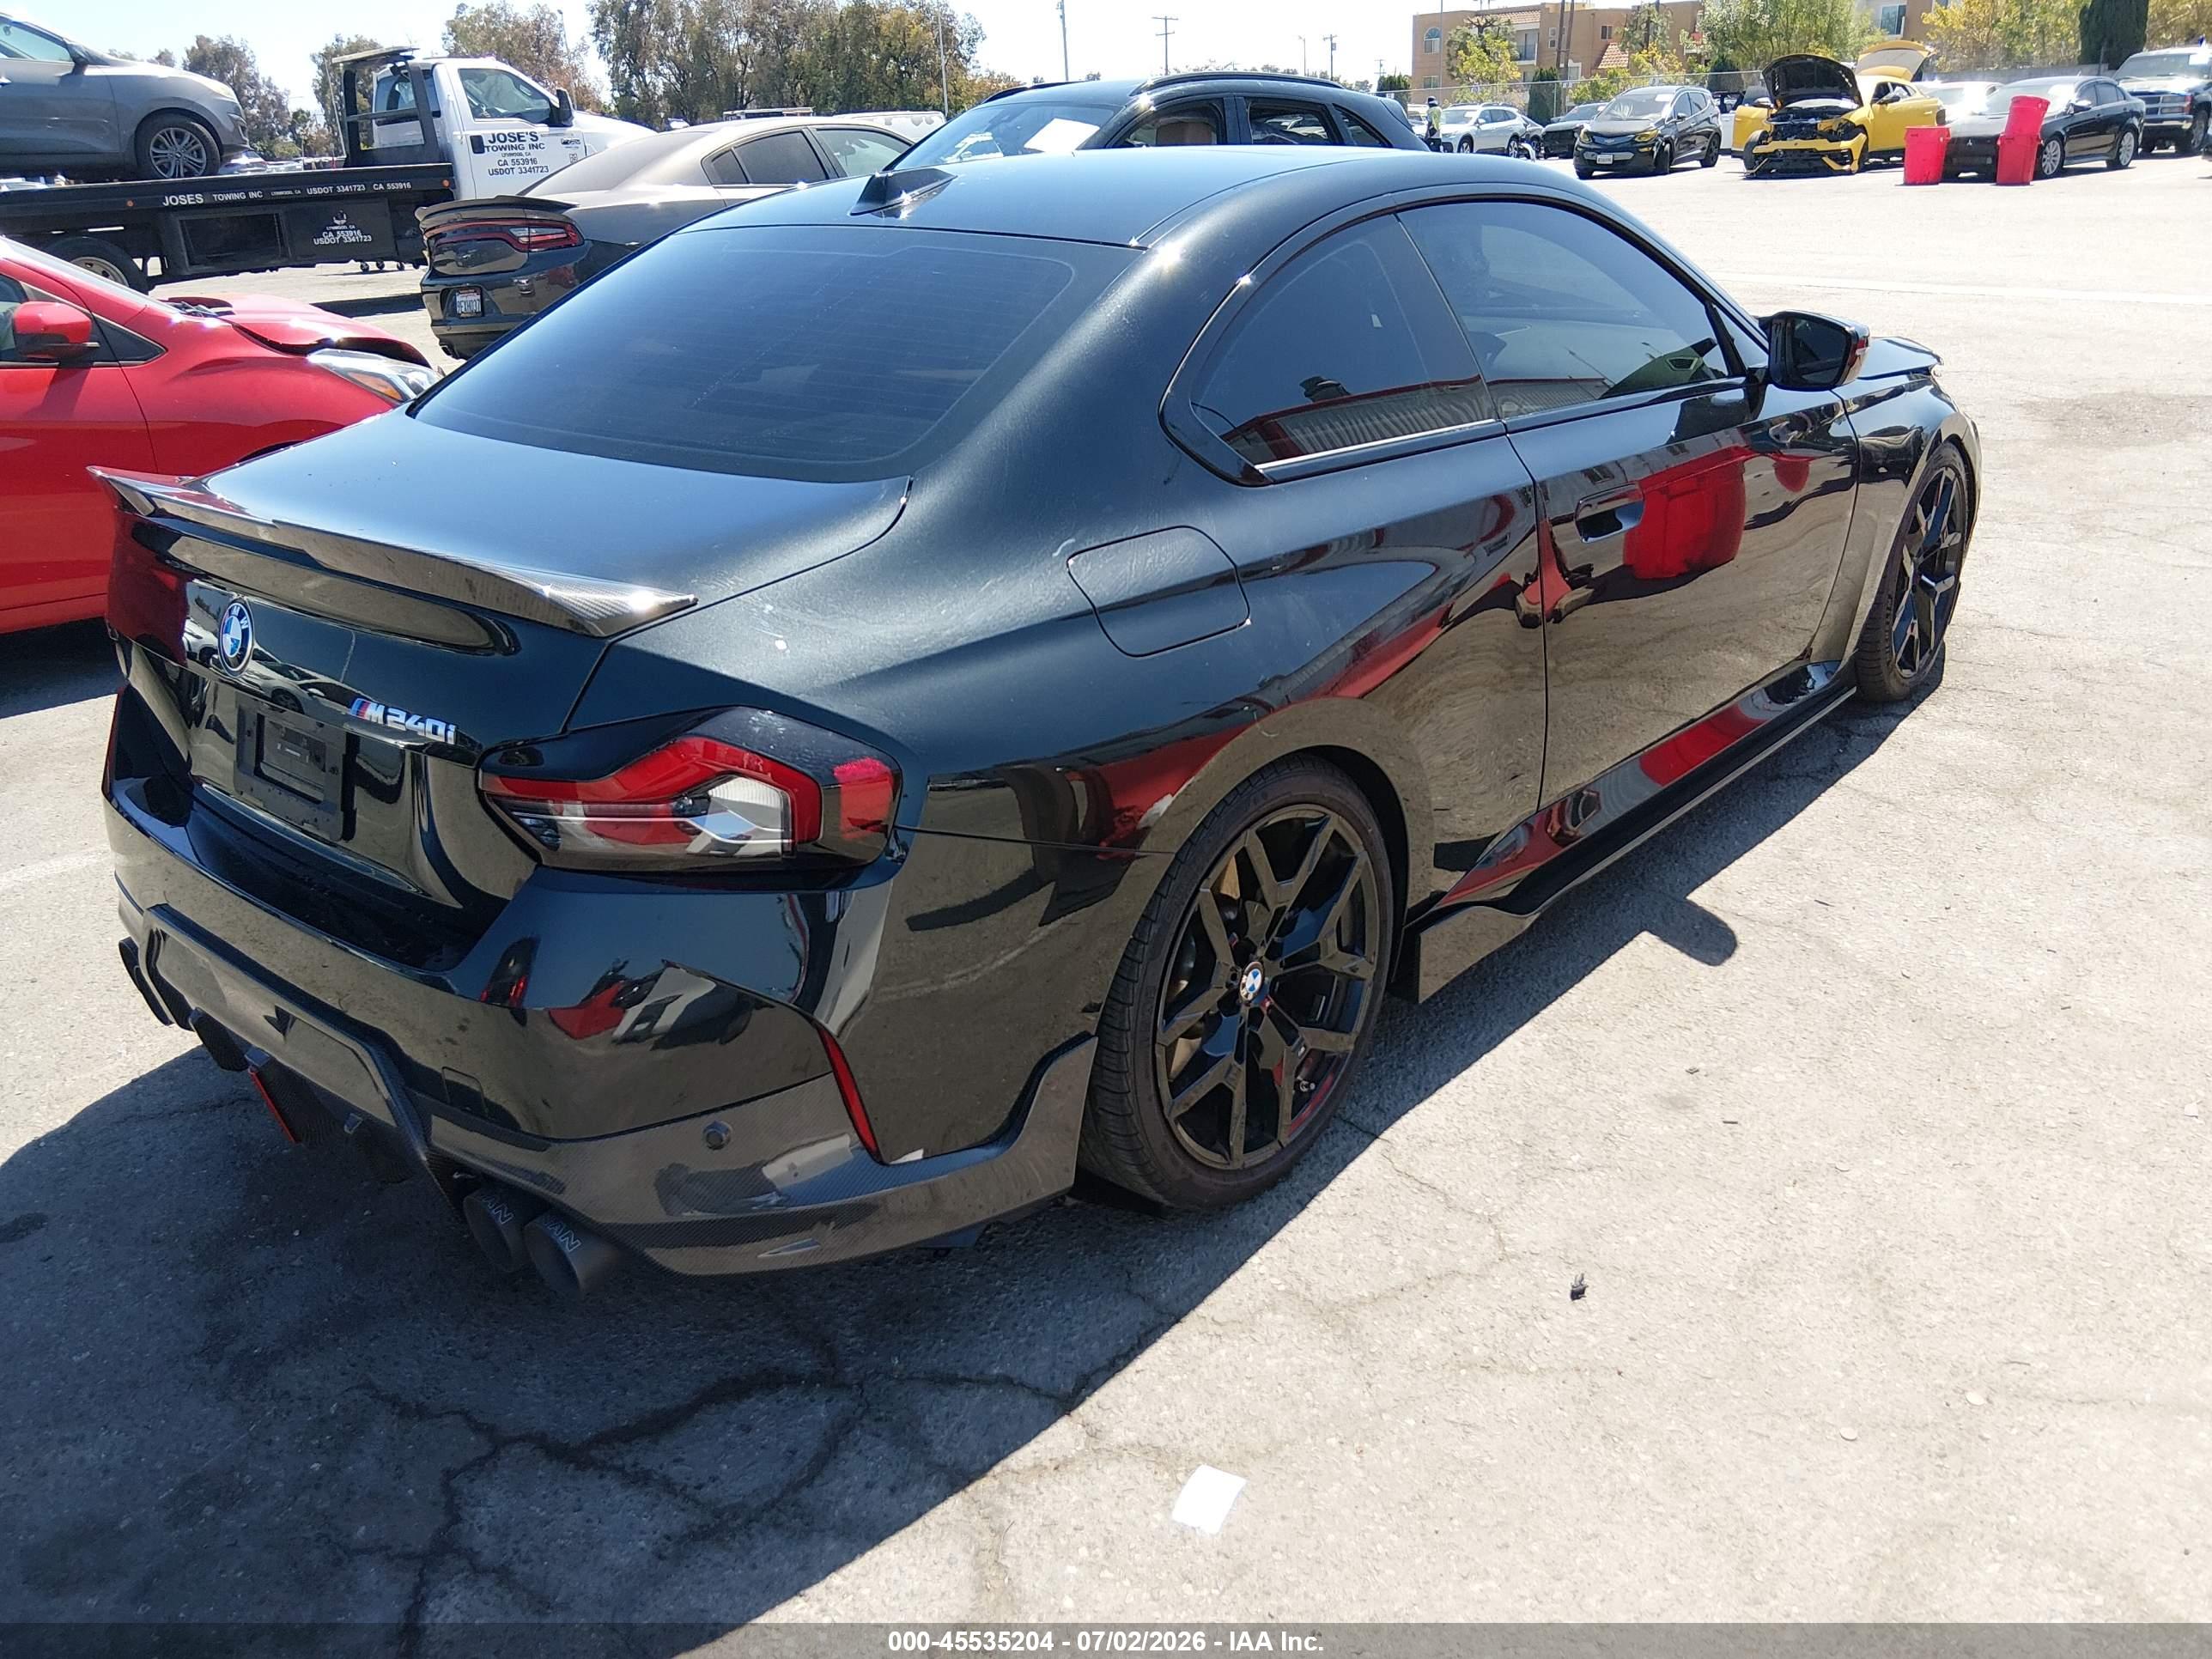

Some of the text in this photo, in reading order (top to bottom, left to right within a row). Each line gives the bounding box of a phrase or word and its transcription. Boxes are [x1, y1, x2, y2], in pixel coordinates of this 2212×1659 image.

[488, 131, 539, 144] JOSE'S
[485, 143, 526, 153] TOWING
[488, 165, 550, 176] USDOT 3341723
[162, 193, 204, 206] JOSES
[212, 191, 247, 201] TOWING
[307, 186, 334, 195] USDOT
[336, 184, 366, 193] 3341723
[313, 234, 373, 246] USDOT 3341723
[336, 229, 362, 239] 553916
[362, 699, 457, 744] M240i
